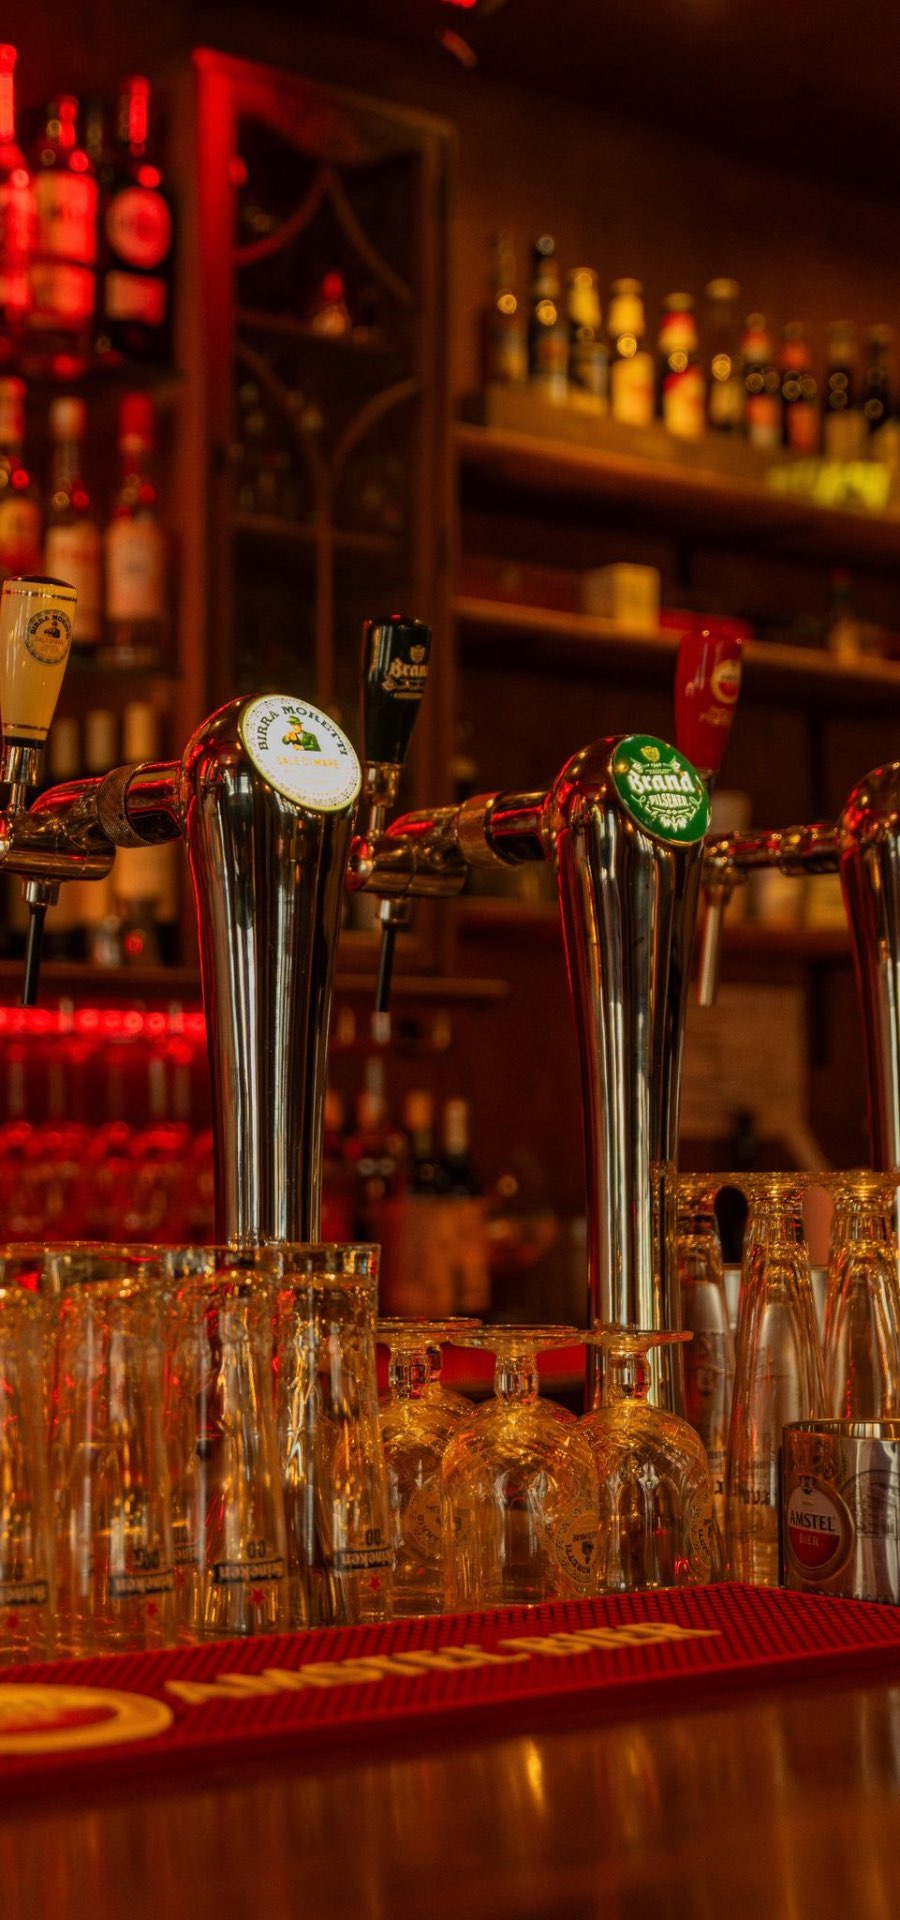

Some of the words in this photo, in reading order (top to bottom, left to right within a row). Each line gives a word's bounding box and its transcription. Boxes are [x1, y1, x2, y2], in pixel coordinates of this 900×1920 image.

[389, 657, 429, 679] Bran
[257, 710, 280, 751] BIRRA
[281, 705, 349, 756] MORETTI
[627, 768, 696, 795] Brand
[648, 793, 689, 809] PILSENER
[789, 1509, 835, 1532] AMSTEL
[799, 1534, 820, 1547] BIER
[165, 1644, 530, 1702] AMSTEL
[499, 1622, 722, 1656] BIER
